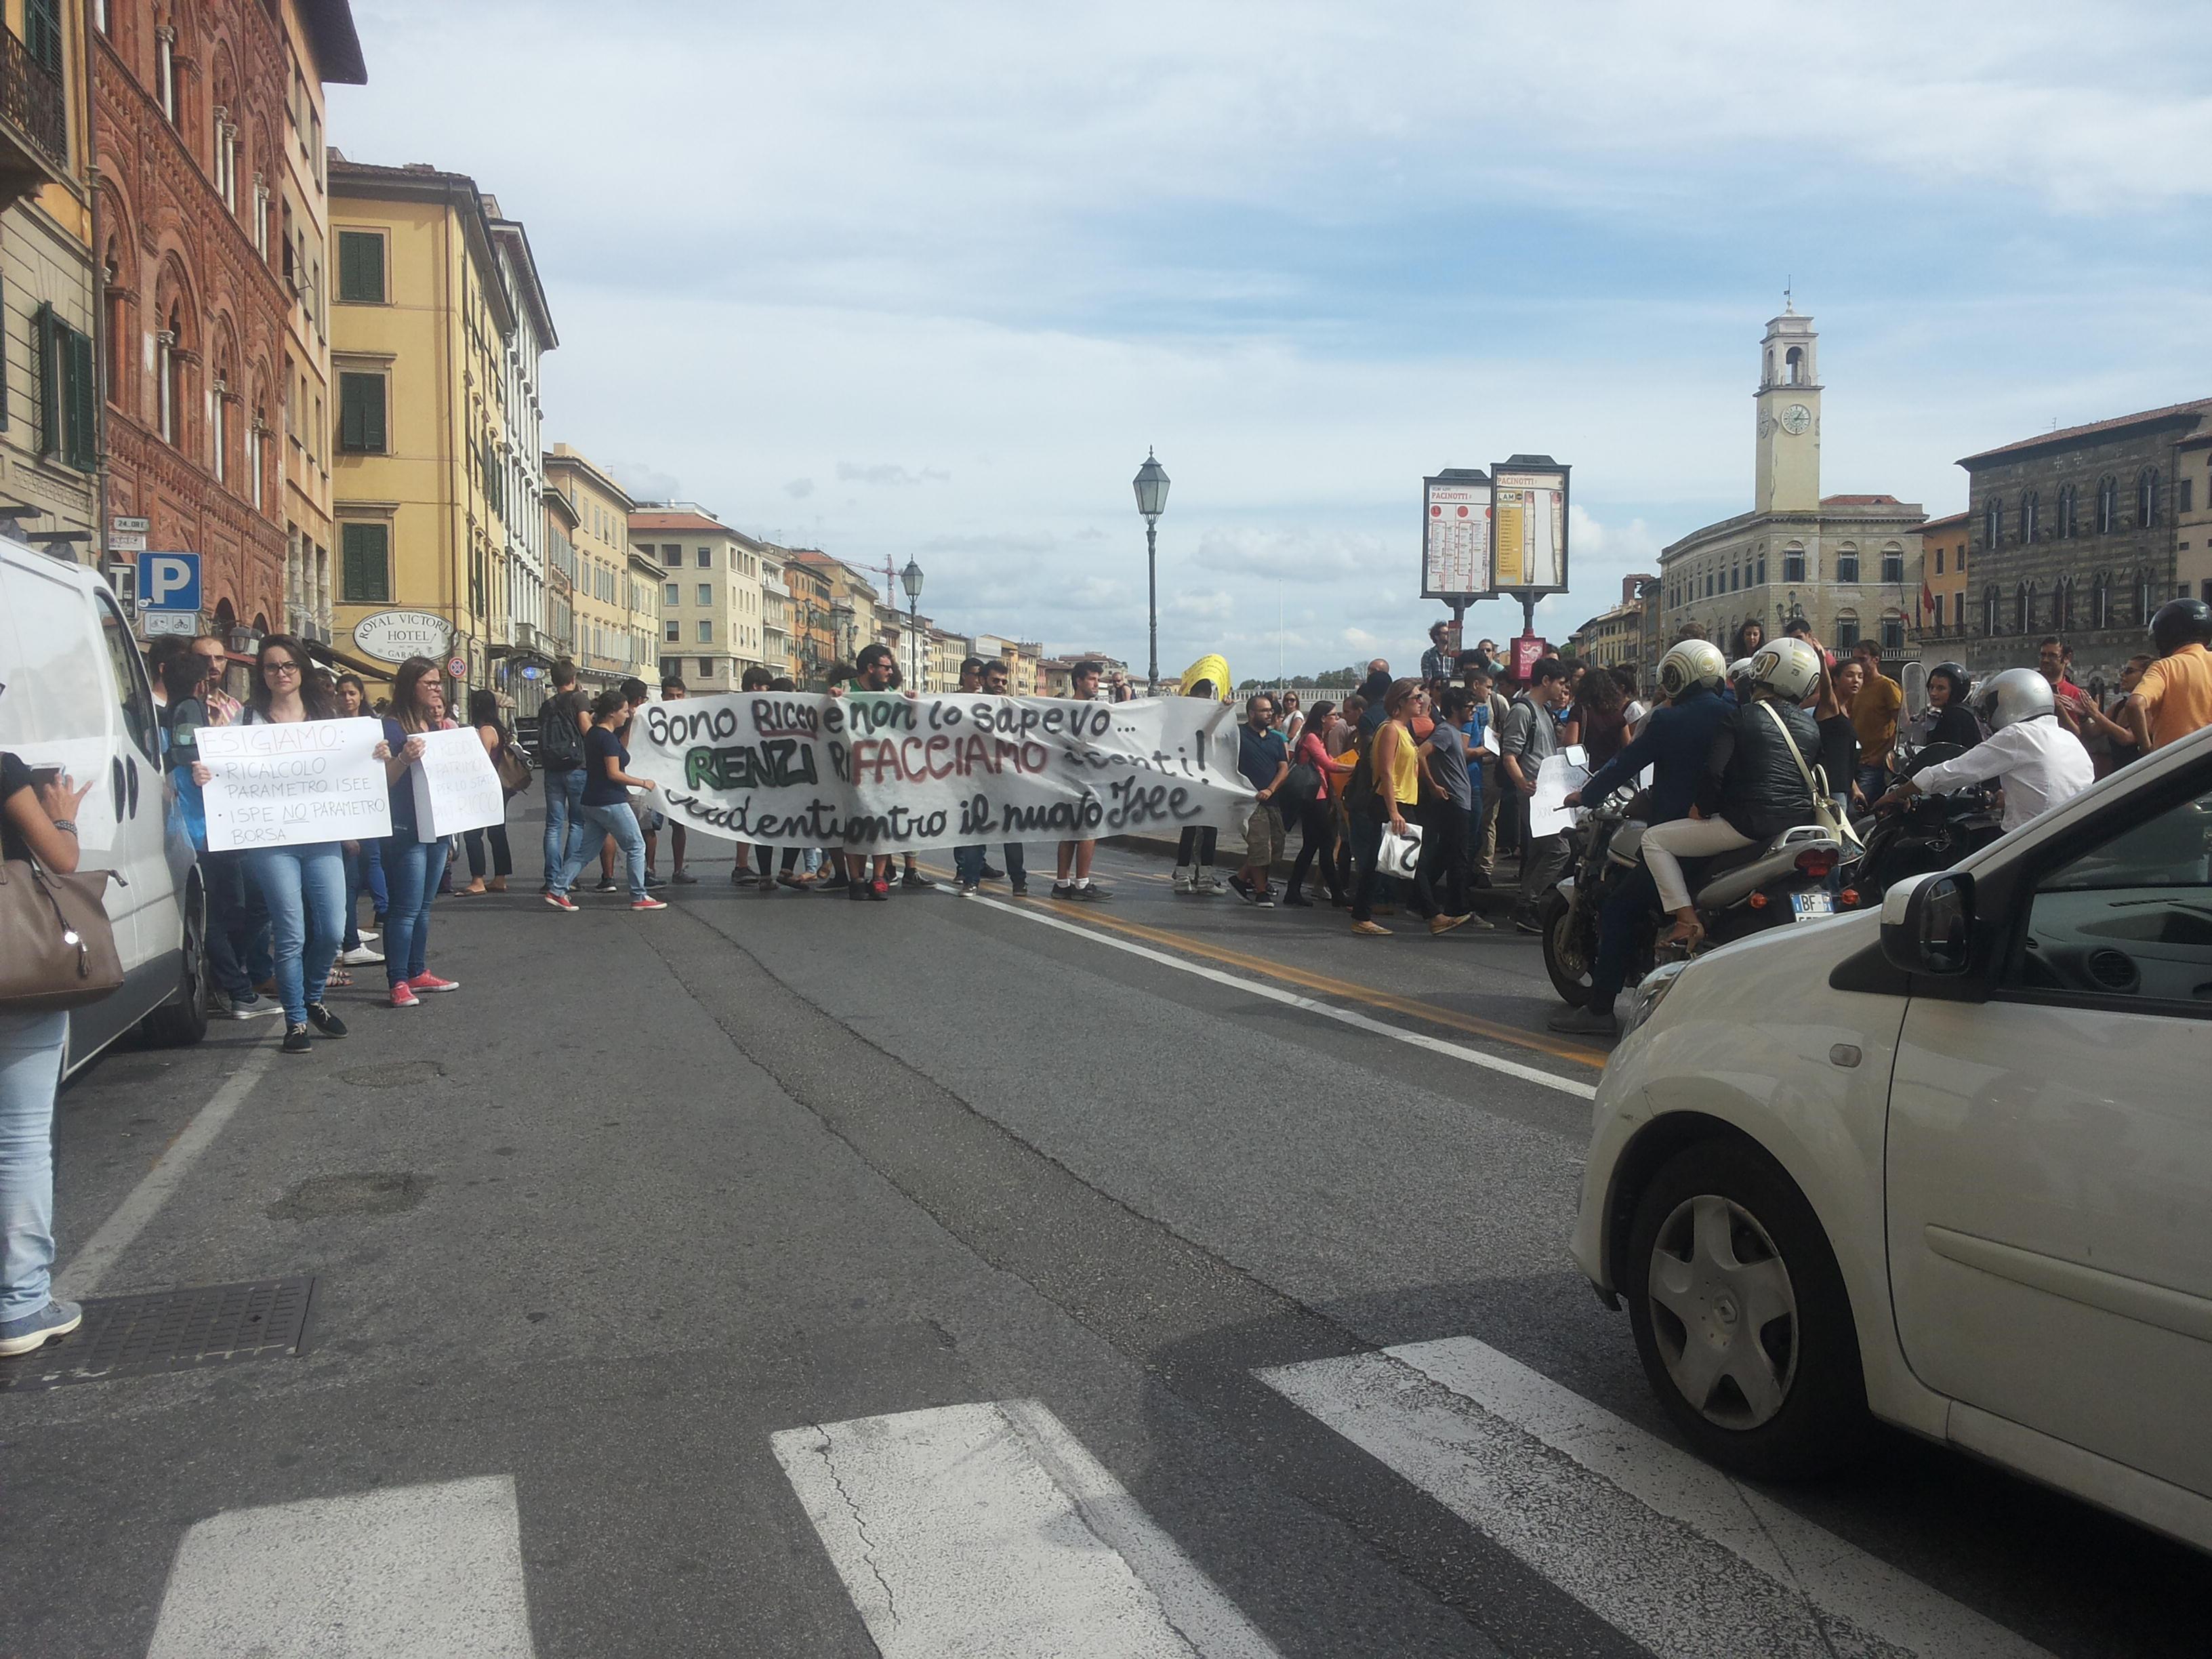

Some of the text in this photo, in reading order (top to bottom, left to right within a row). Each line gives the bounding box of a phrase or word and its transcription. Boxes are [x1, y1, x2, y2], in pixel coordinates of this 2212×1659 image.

[1498, 477, 1534, 485] PACINOTTI
[1432, 492, 1468, 500] PACINOTTI
[109, 567, 130, 600] T
[152, 558, 190, 604] P
[359, 616, 394, 639] ROYAL
[388, 631, 430, 640] HOTEL
[388, 649, 424, 659] GARAGE
[648, 706, 738, 746] Sono
[823, 706, 844, 734] e
[849, 700, 918, 735] non
[928, 700, 962, 731] lo
[202, 725, 345, 754] ESIGIAMO:
[225, 756, 327, 779] RICALCOLO
[684, 739, 818, 791] RENZI
[224, 777, 371, 799] PARAMETRO ISEE
[455, 780, 467, 792] LO
[230, 798, 386, 823] ISPE NO PARAMETRO
[457, 792, 499, 817] RICCO
[959, 794, 999, 834] il
[1002, 791, 1103, 833] nuovo
[232, 828, 287, 845] BORSA
[1801, 895, 1816, 911] BF
